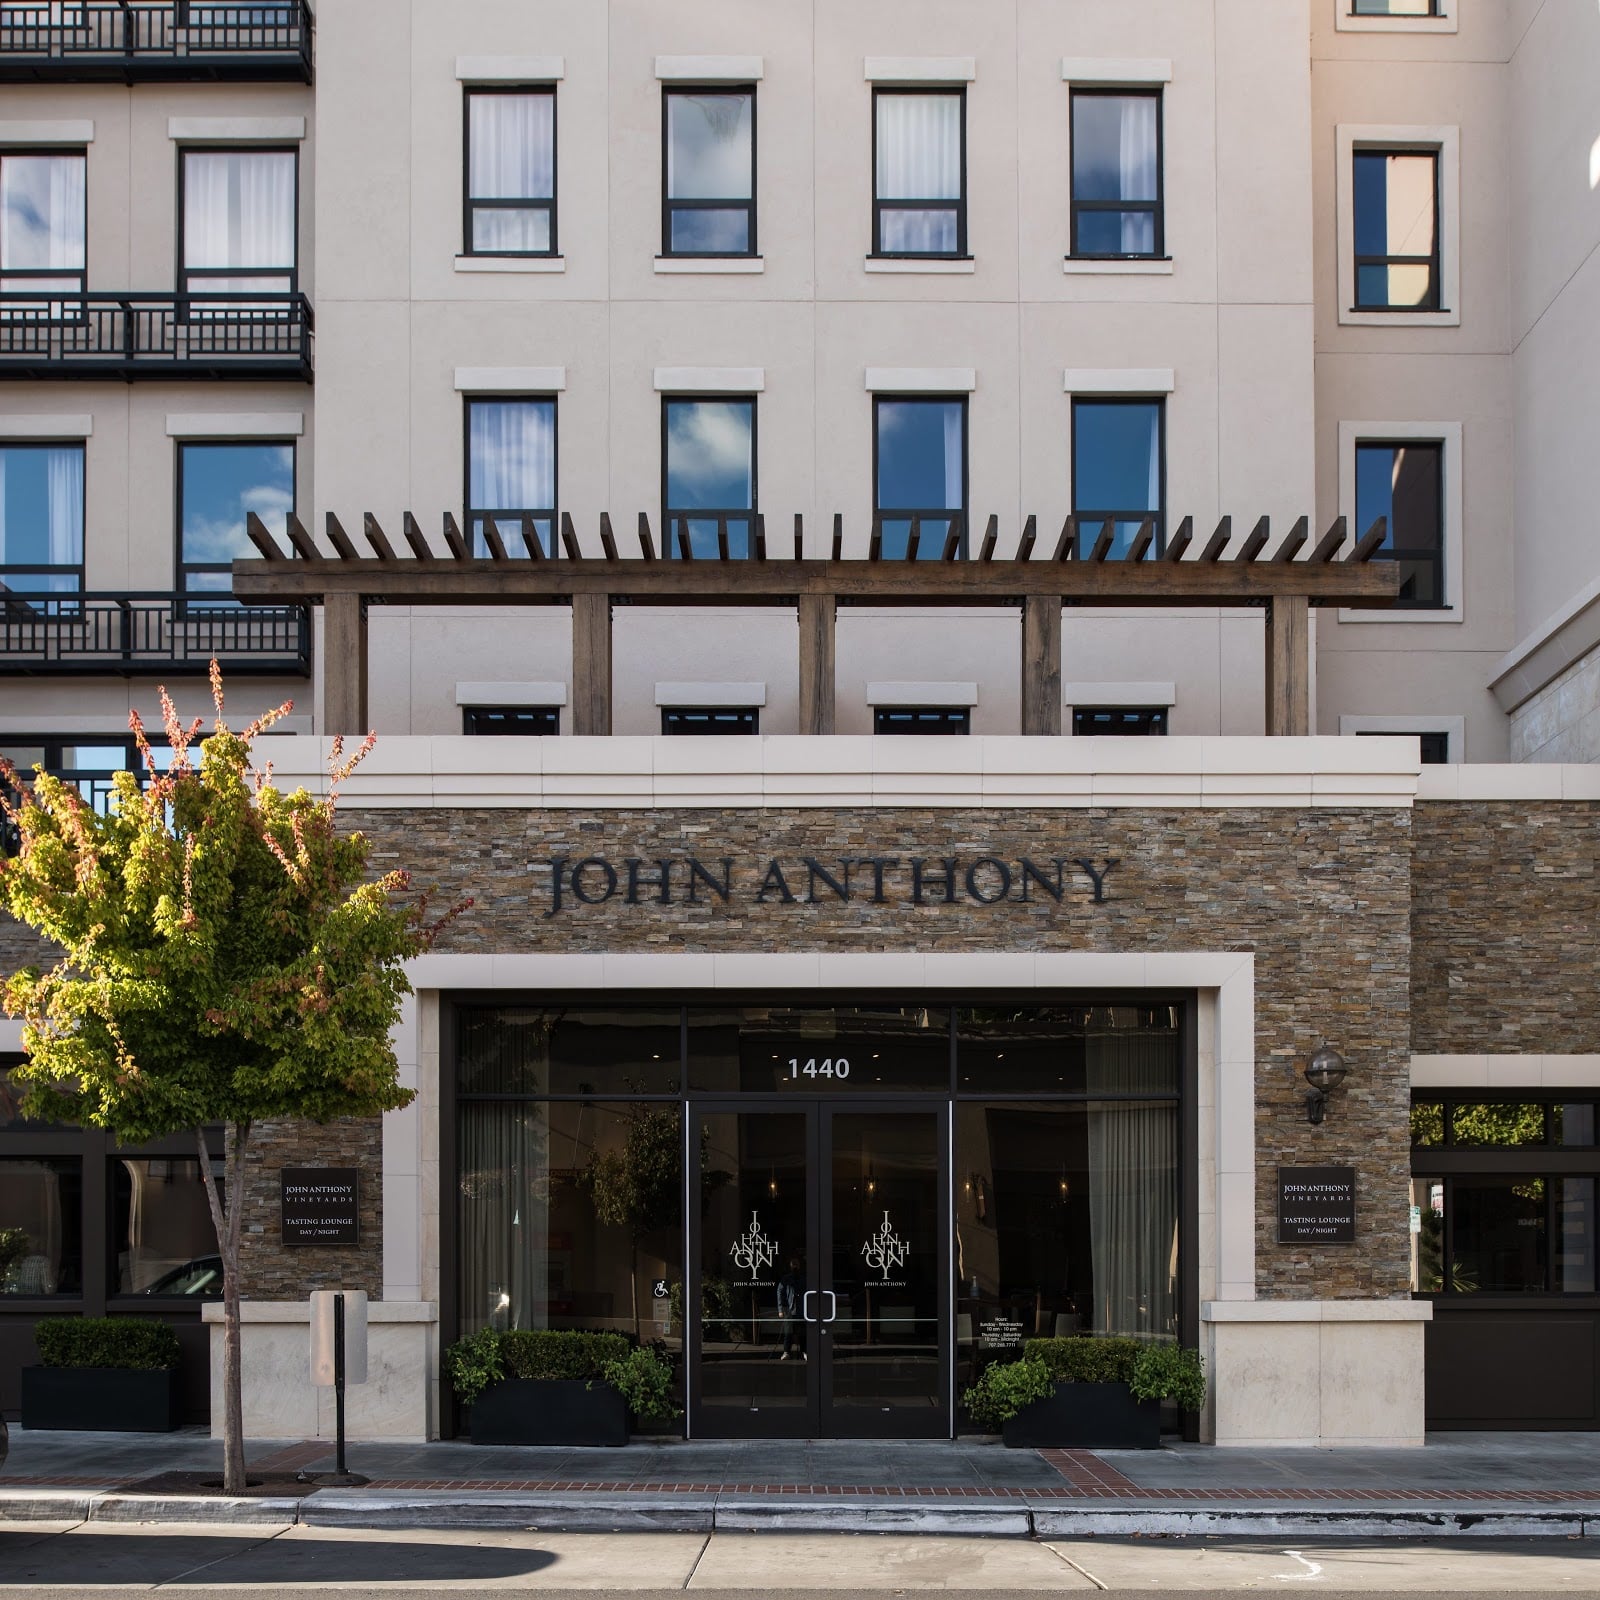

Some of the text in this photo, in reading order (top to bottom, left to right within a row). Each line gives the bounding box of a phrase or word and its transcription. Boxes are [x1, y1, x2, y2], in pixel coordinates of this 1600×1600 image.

[543, 857, 1121, 919] JOHN ANTHONY
[788, 1058, 850, 1079] 1440
[286, 1186, 308, 1194] JOHN
[1284, 1185, 1306, 1193] JOHN
